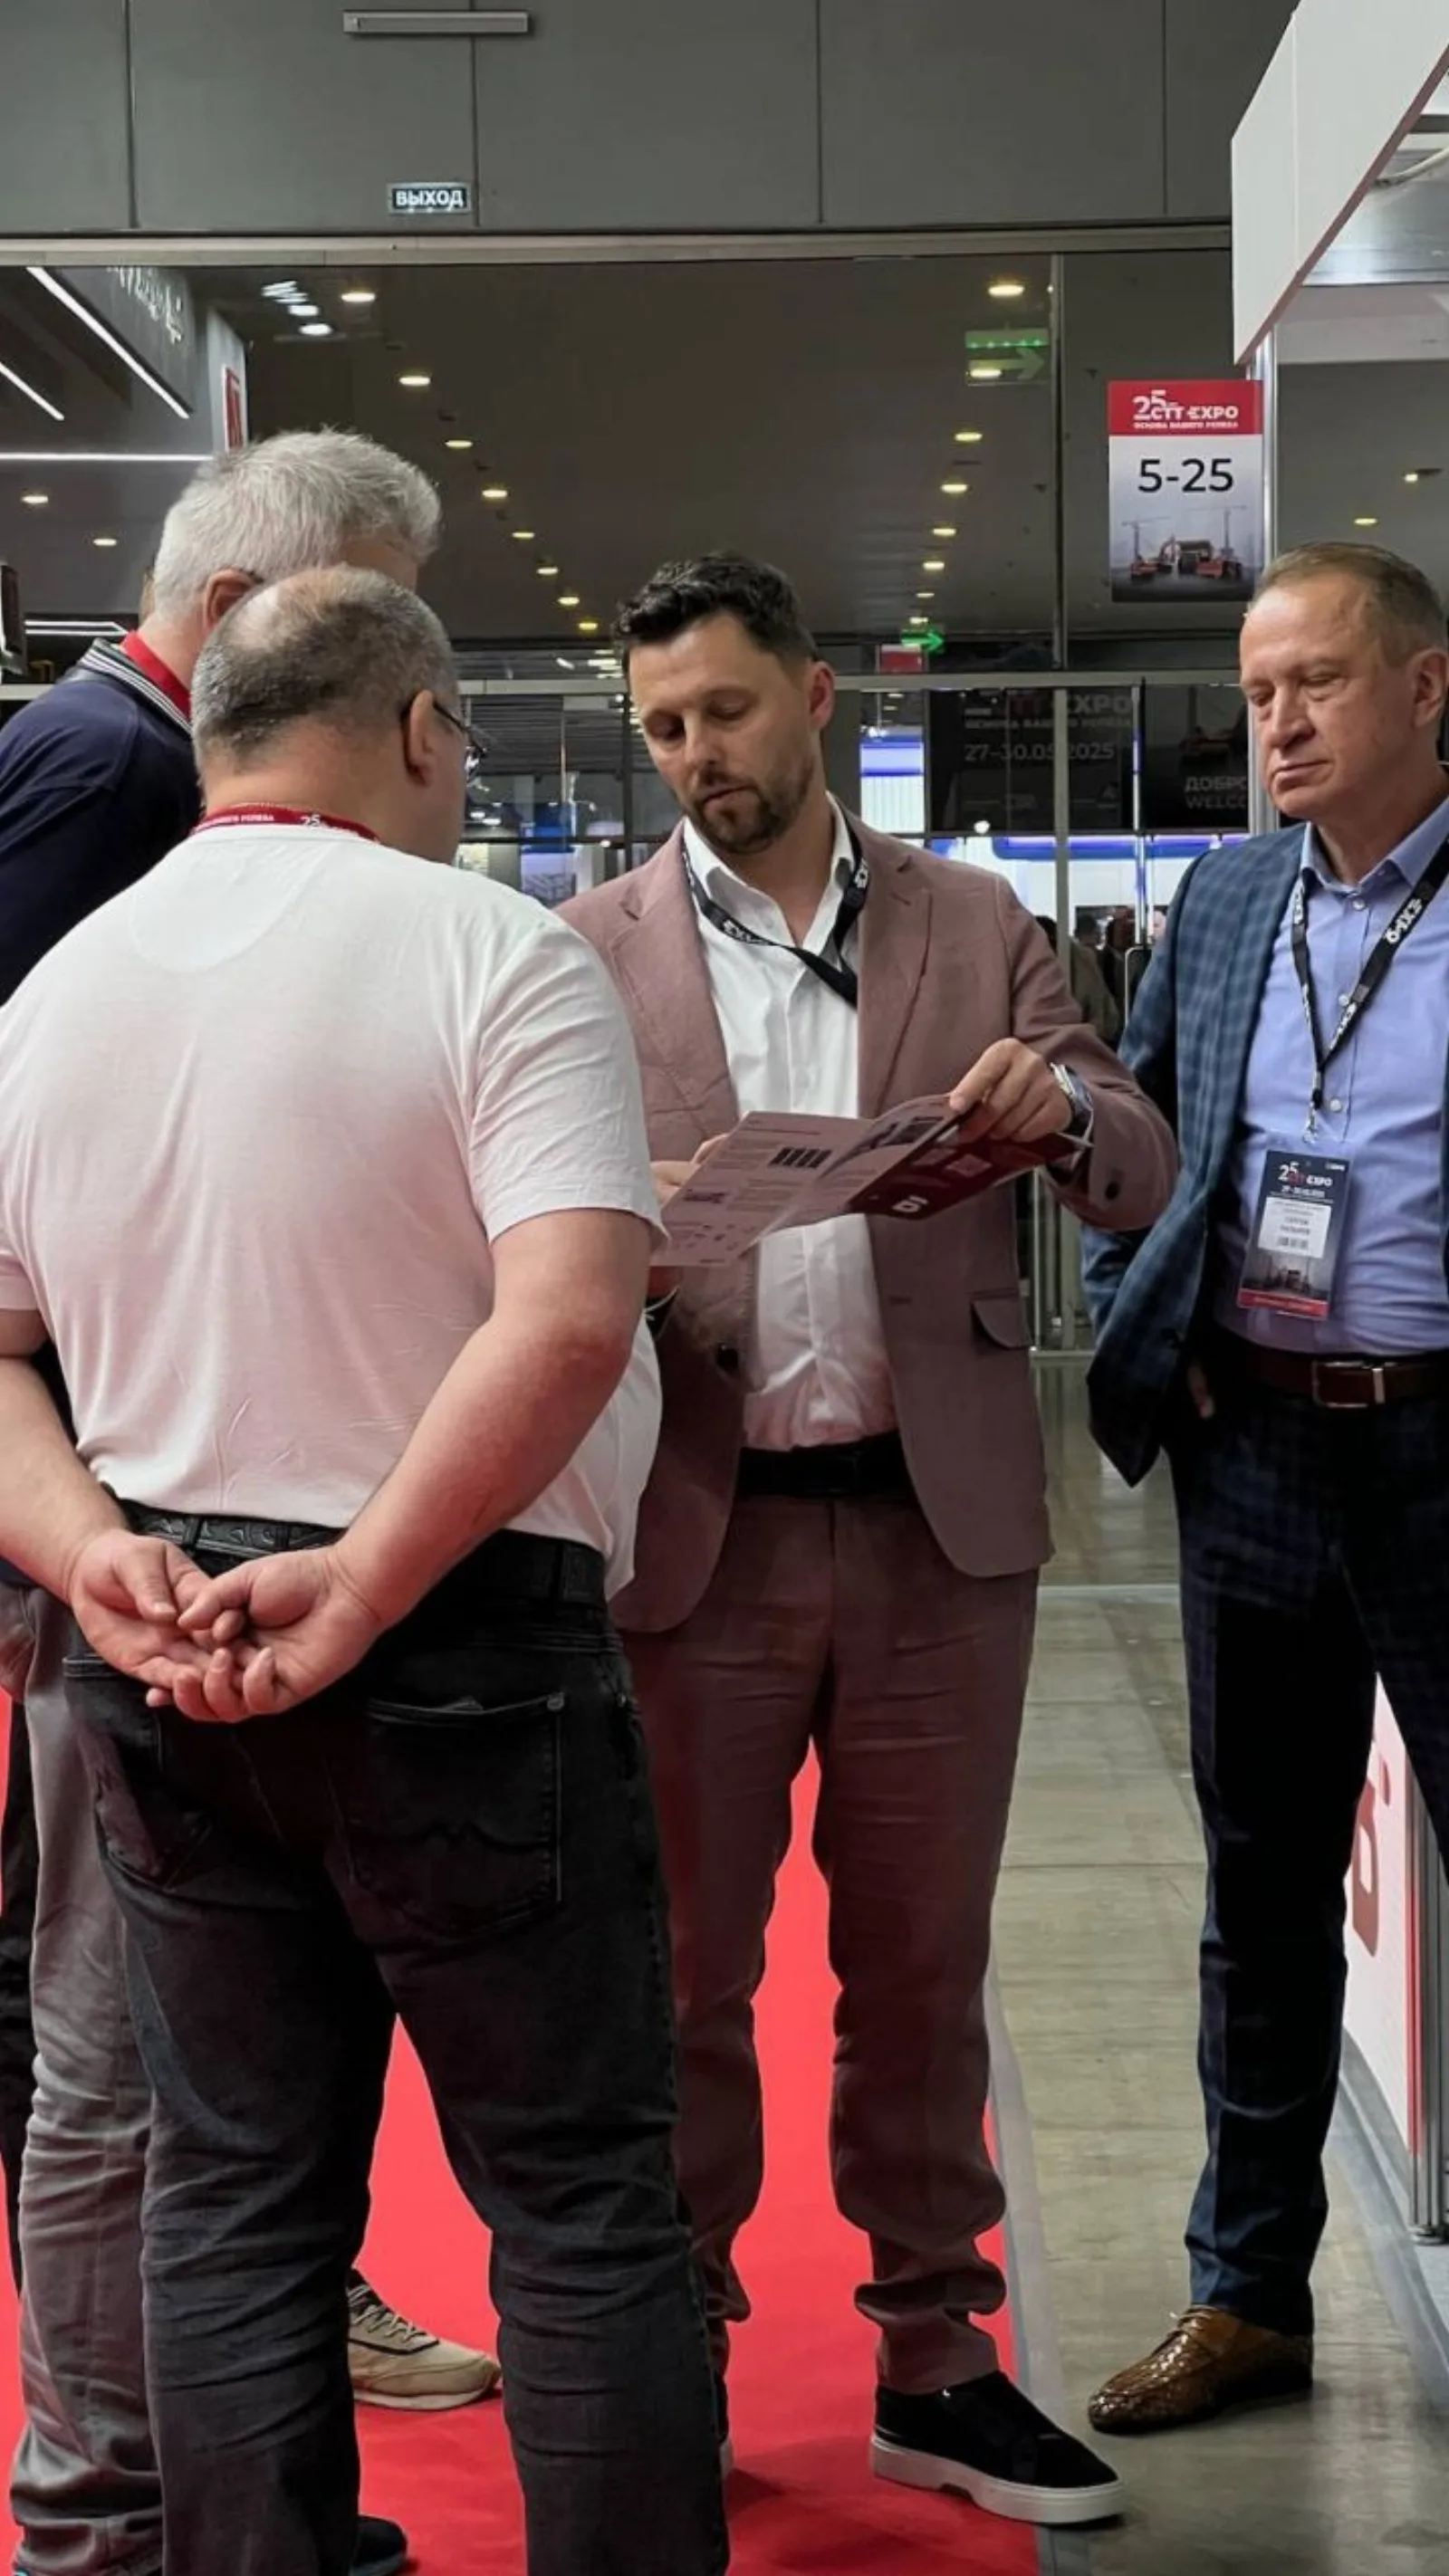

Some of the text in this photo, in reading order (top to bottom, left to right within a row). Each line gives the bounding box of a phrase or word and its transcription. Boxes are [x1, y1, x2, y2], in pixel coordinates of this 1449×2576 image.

[396, 189, 464, 208] ВЫХОД
[1186, 406, 1239, 419] EXPO
[1138, 458, 1233, 493] 5-25
[1068, 694, 1131, 714] XPO
